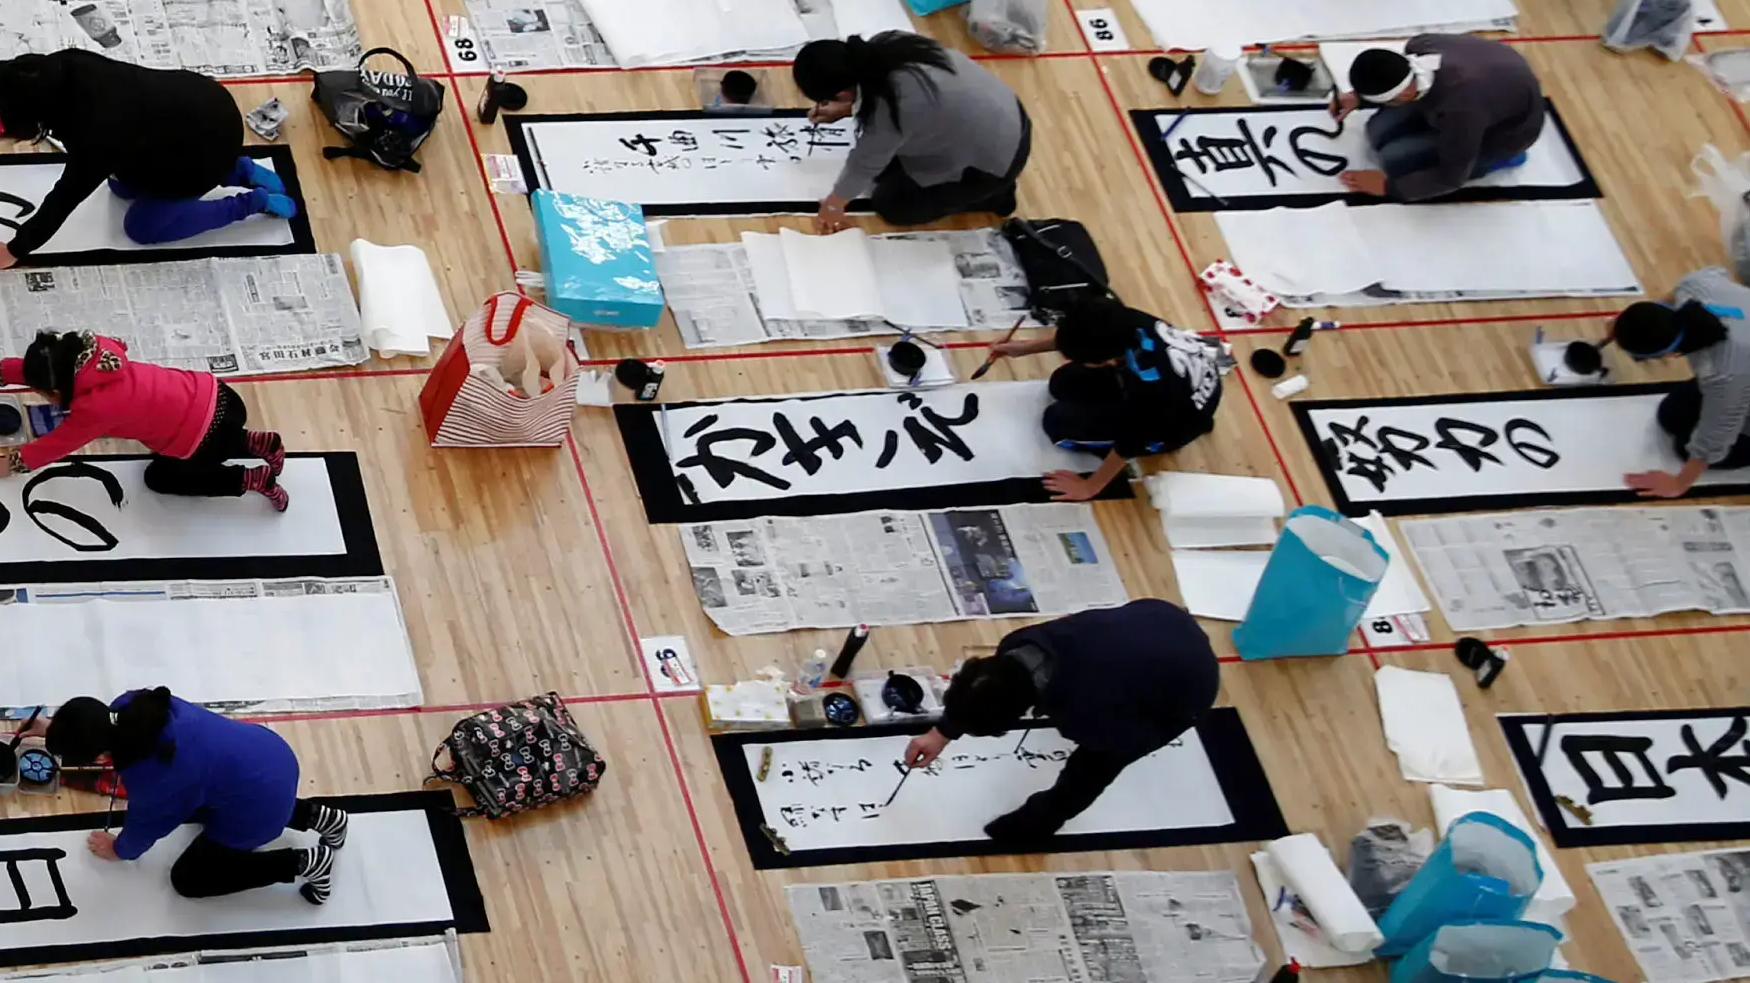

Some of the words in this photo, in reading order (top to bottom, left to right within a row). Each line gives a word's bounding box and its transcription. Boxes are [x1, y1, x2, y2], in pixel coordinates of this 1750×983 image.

[455, 38, 478, 62] 68
[1089, 18, 1114, 41] 86
[1175, 119, 1347, 188] 真の
[1326, 415, 1561, 494] 努力の
[1559, 716, 1750, 806] 日本
